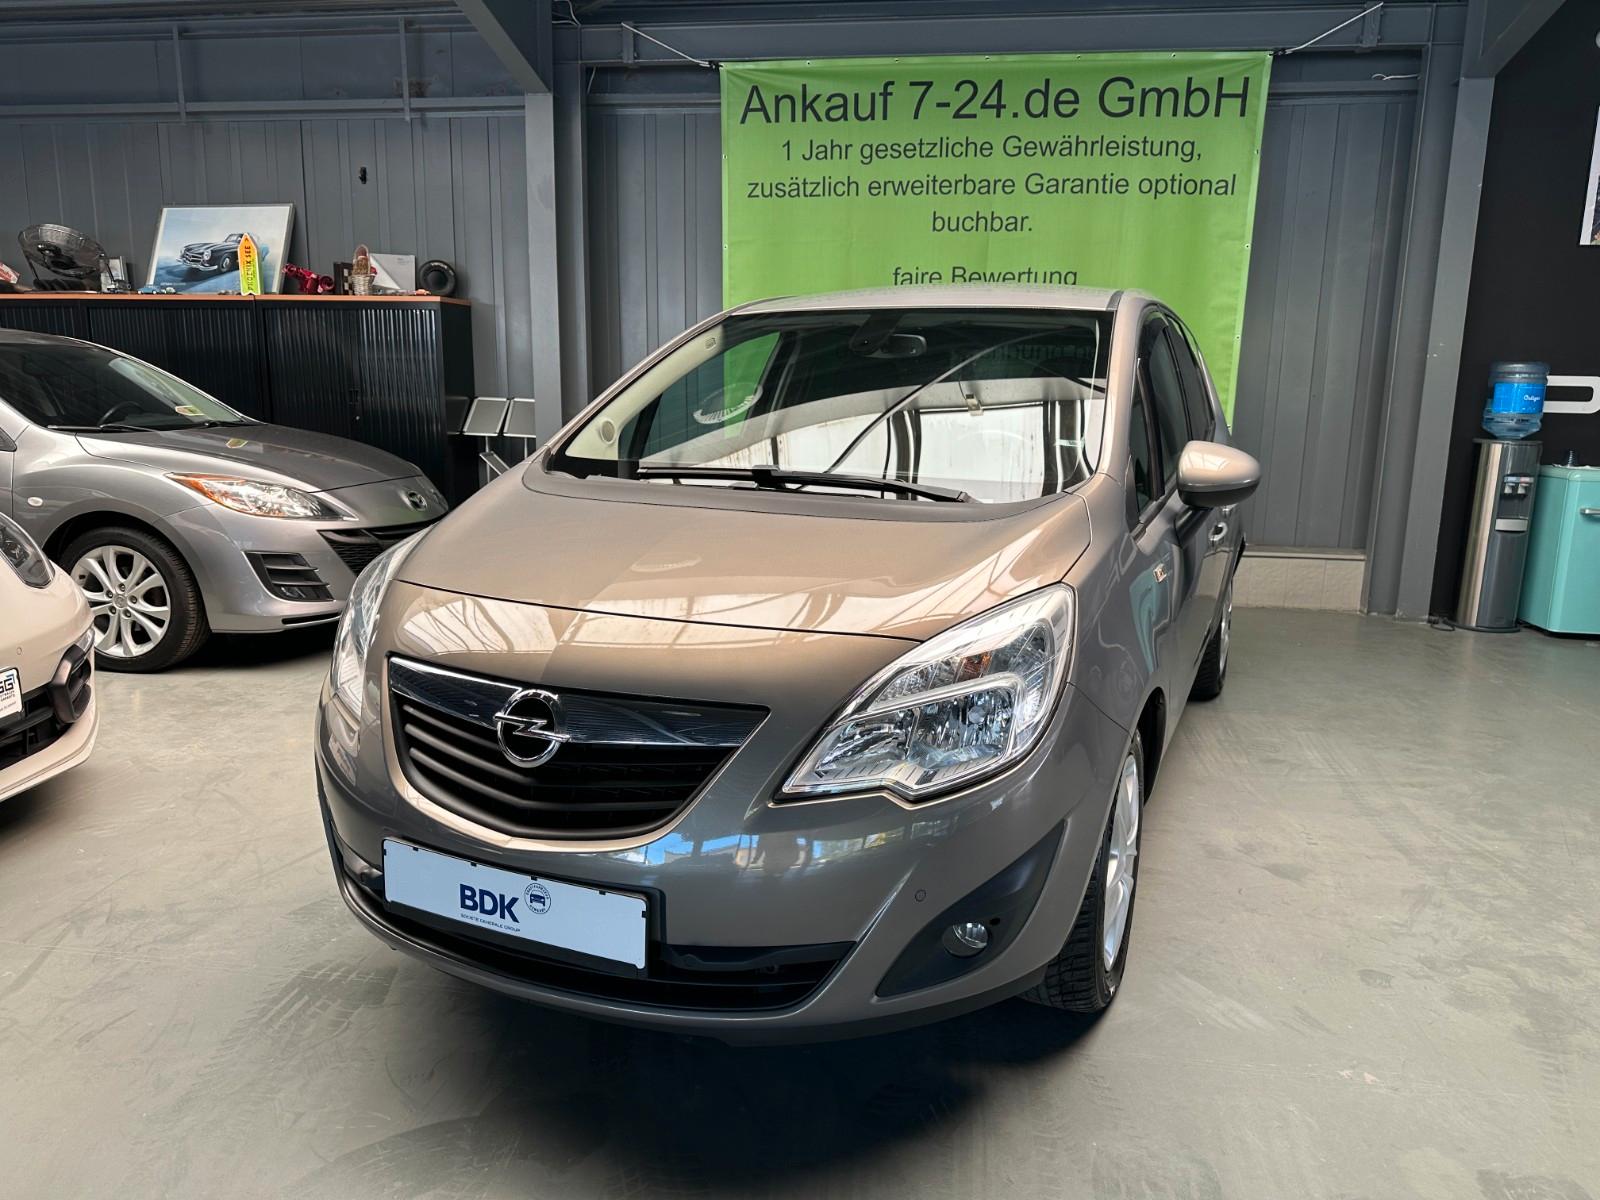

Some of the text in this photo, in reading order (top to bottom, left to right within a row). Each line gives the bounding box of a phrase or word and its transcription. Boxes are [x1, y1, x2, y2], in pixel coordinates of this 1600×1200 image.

[740, 76, 1250, 125] Ankauf 7-24.de GmbH
[782, 134, 1202, 165] 1 Jahr gesetzliche Gewährleistung,
[747, 172, 1237, 201] zusätzlich erweiterbare Garantie optional
[932, 210, 1033, 233] buchbar.
[892, 265, 1078, 286] faire Bewertung
[460, 883, 519, 924] BDK
